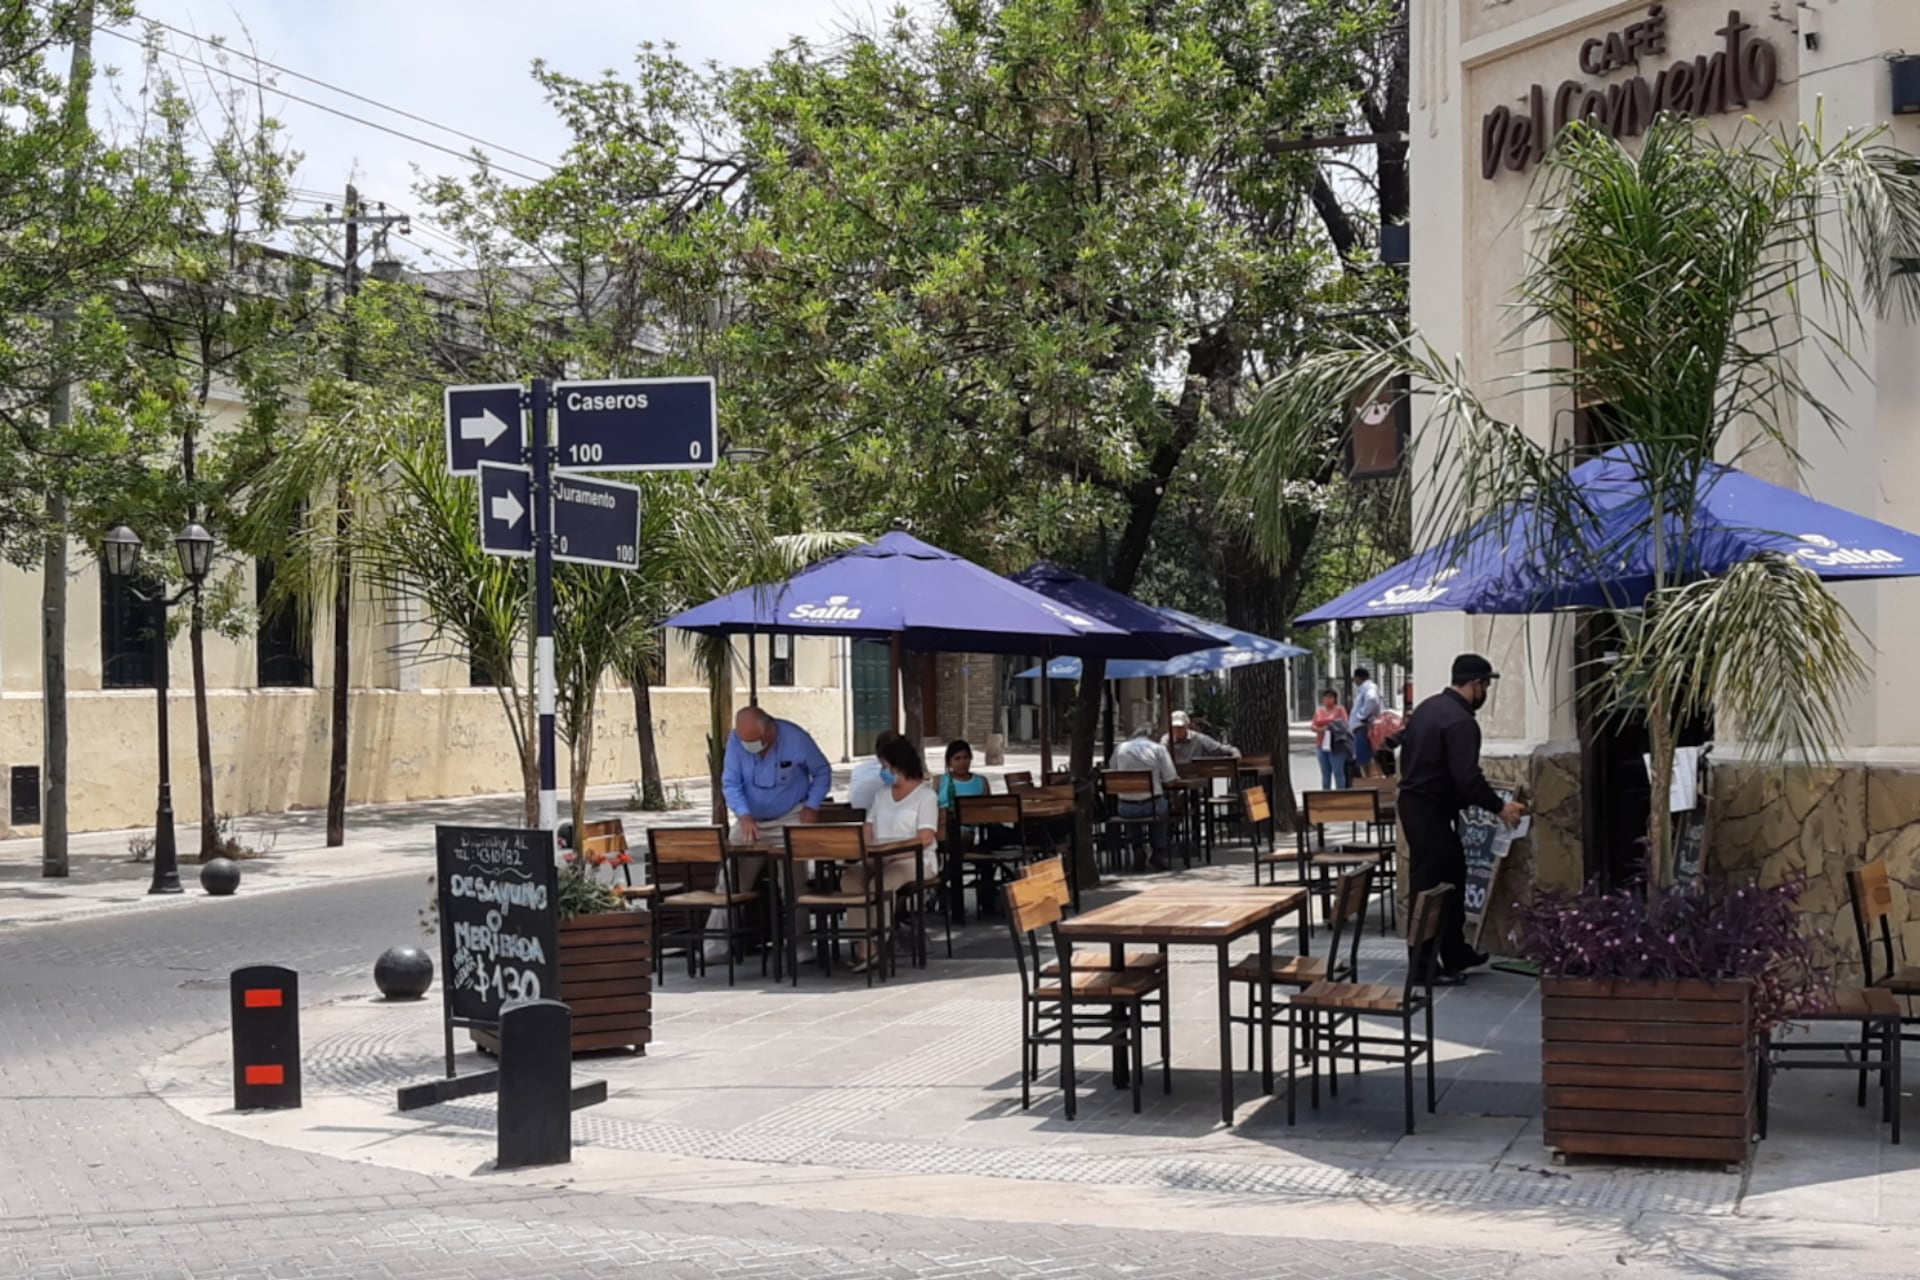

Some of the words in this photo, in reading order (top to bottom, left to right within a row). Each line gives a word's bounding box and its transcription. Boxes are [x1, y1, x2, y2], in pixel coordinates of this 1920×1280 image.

[1579, 4, 1665, 75] CAFÉ
[1482, 84, 1544, 180] Del
[566, 391, 649, 412] Caseros
[569, 443, 603, 463] 100
[689, 440, 702, 460] 0
[555, 481, 616, 509] Juramento
[560, 535, 569, 554] 0
[616, 545, 635, 562] 100
[1797, 547, 1904, 566] Salta
[788, 603, 862, 620] Salta
[451, 874, 548, 917] DESAYUNO
[486, 908, 503, 933] O
[454, 921, 546, 965] MERIENDA
[473, 953, 541, 1003] $130
